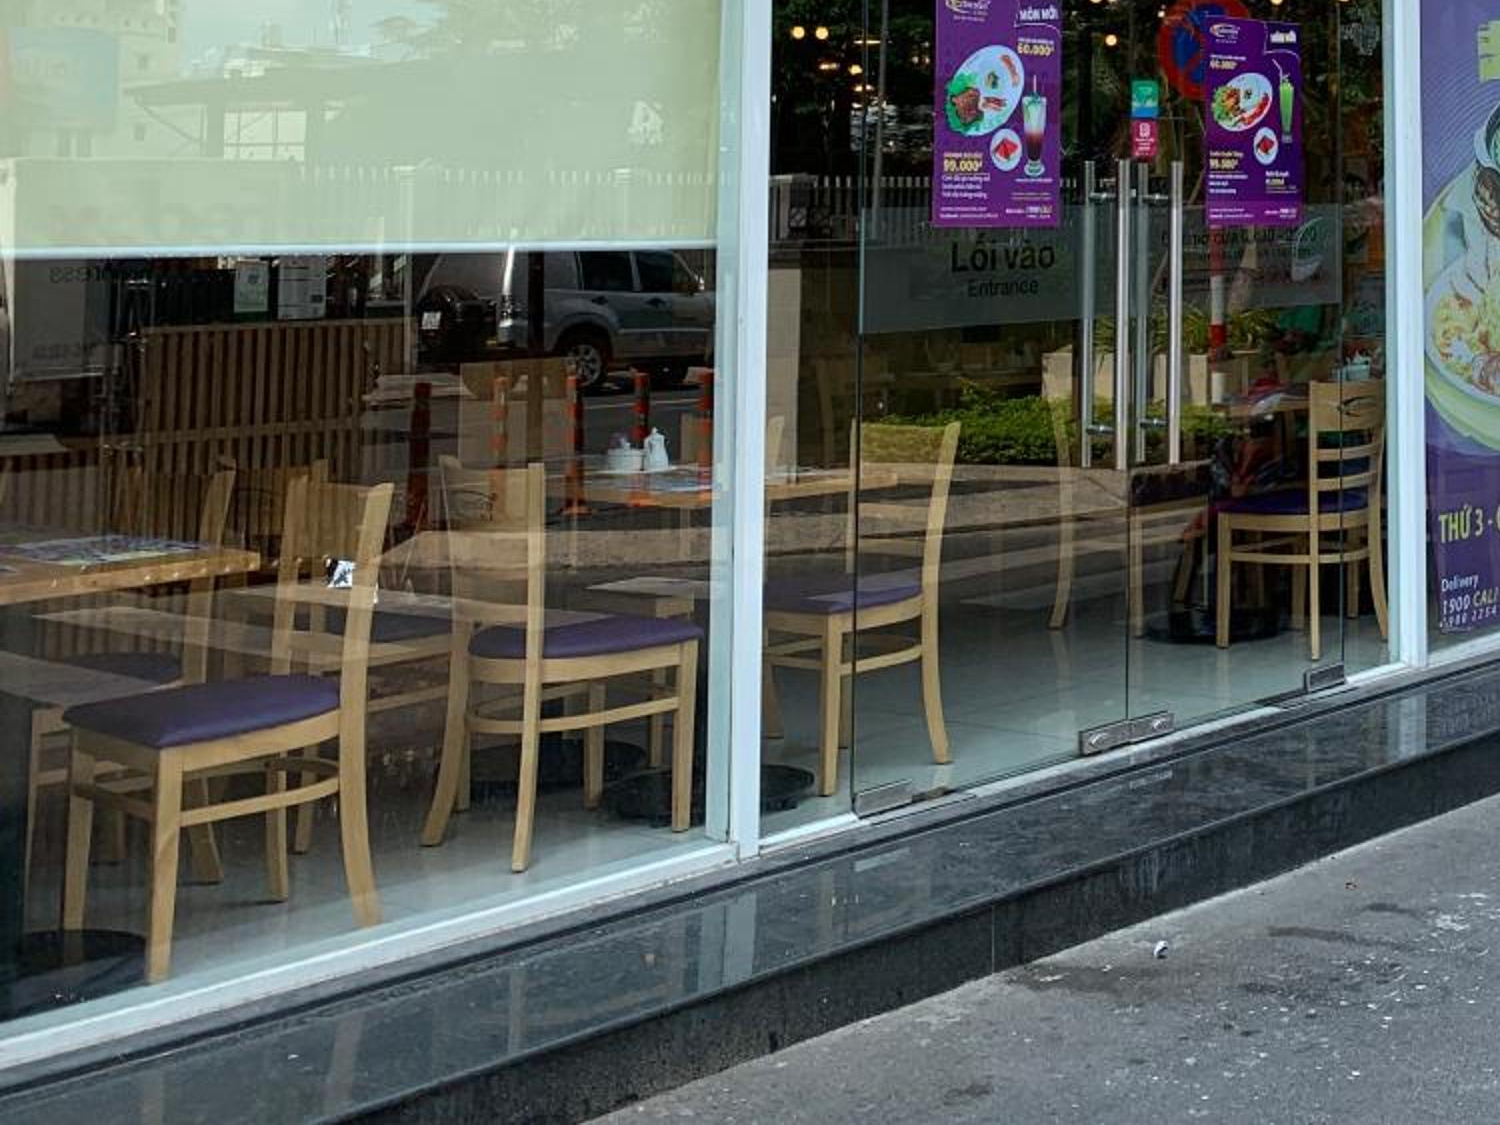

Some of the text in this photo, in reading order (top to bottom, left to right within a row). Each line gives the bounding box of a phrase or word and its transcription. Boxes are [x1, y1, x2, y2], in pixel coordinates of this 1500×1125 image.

[951, 232, 1055, 273] Lối vào
[967, 278, 1038, 298] Entrance
[1474, 507, 1485, 537] 3
[1472, 586, 1499, 608] CALI
